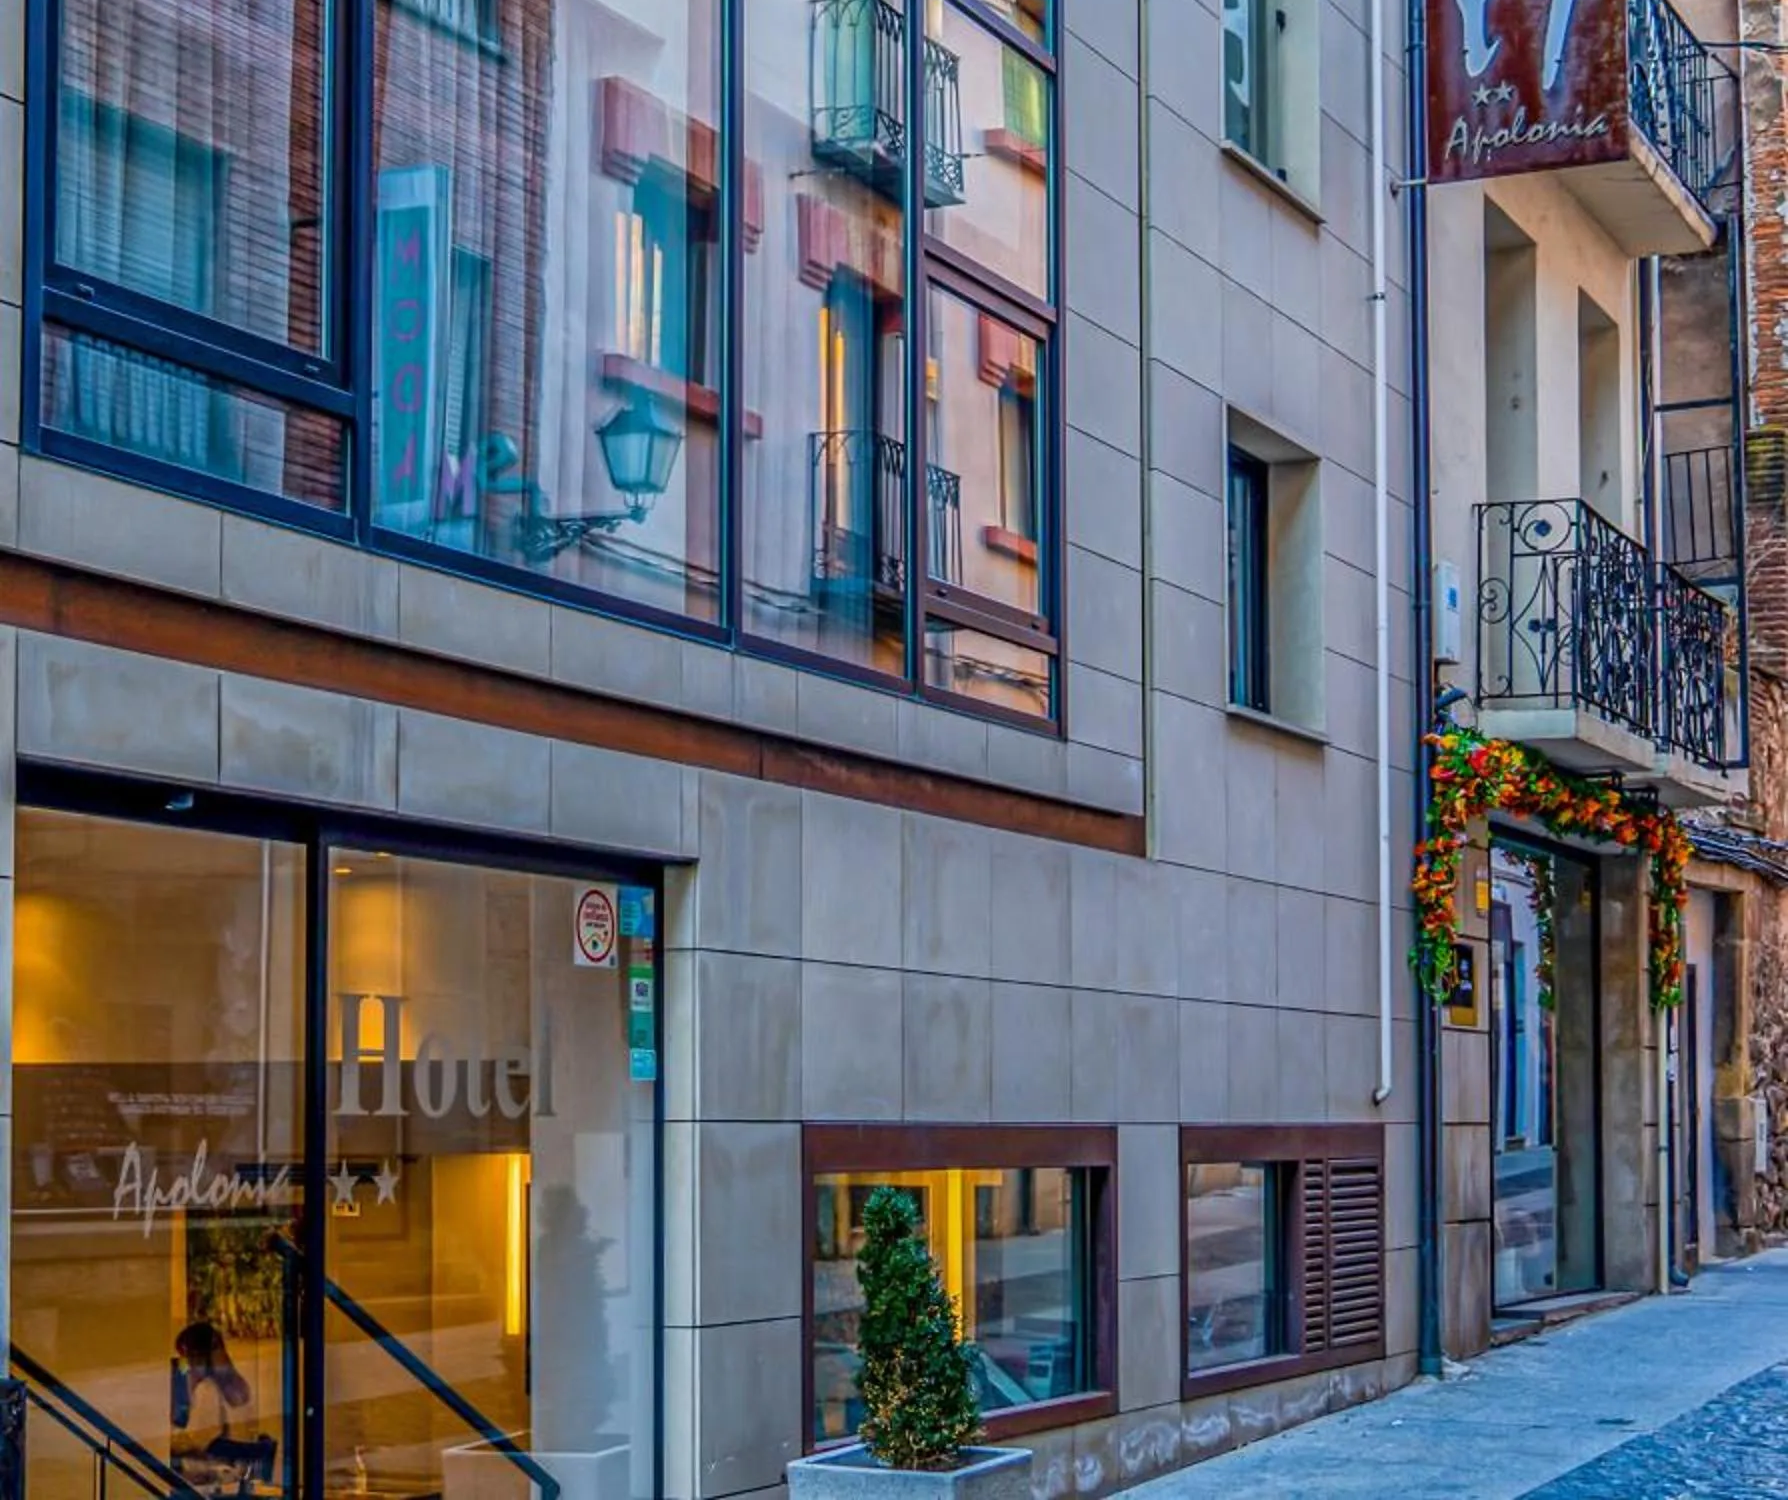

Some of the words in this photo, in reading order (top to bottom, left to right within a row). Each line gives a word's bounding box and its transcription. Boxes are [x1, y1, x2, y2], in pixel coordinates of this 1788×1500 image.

[1444, 103, 1609, 165] Apolonia
[331, 994, 557, 1119] Hotel
[113, 1138, 292, 1239] Apolonia
